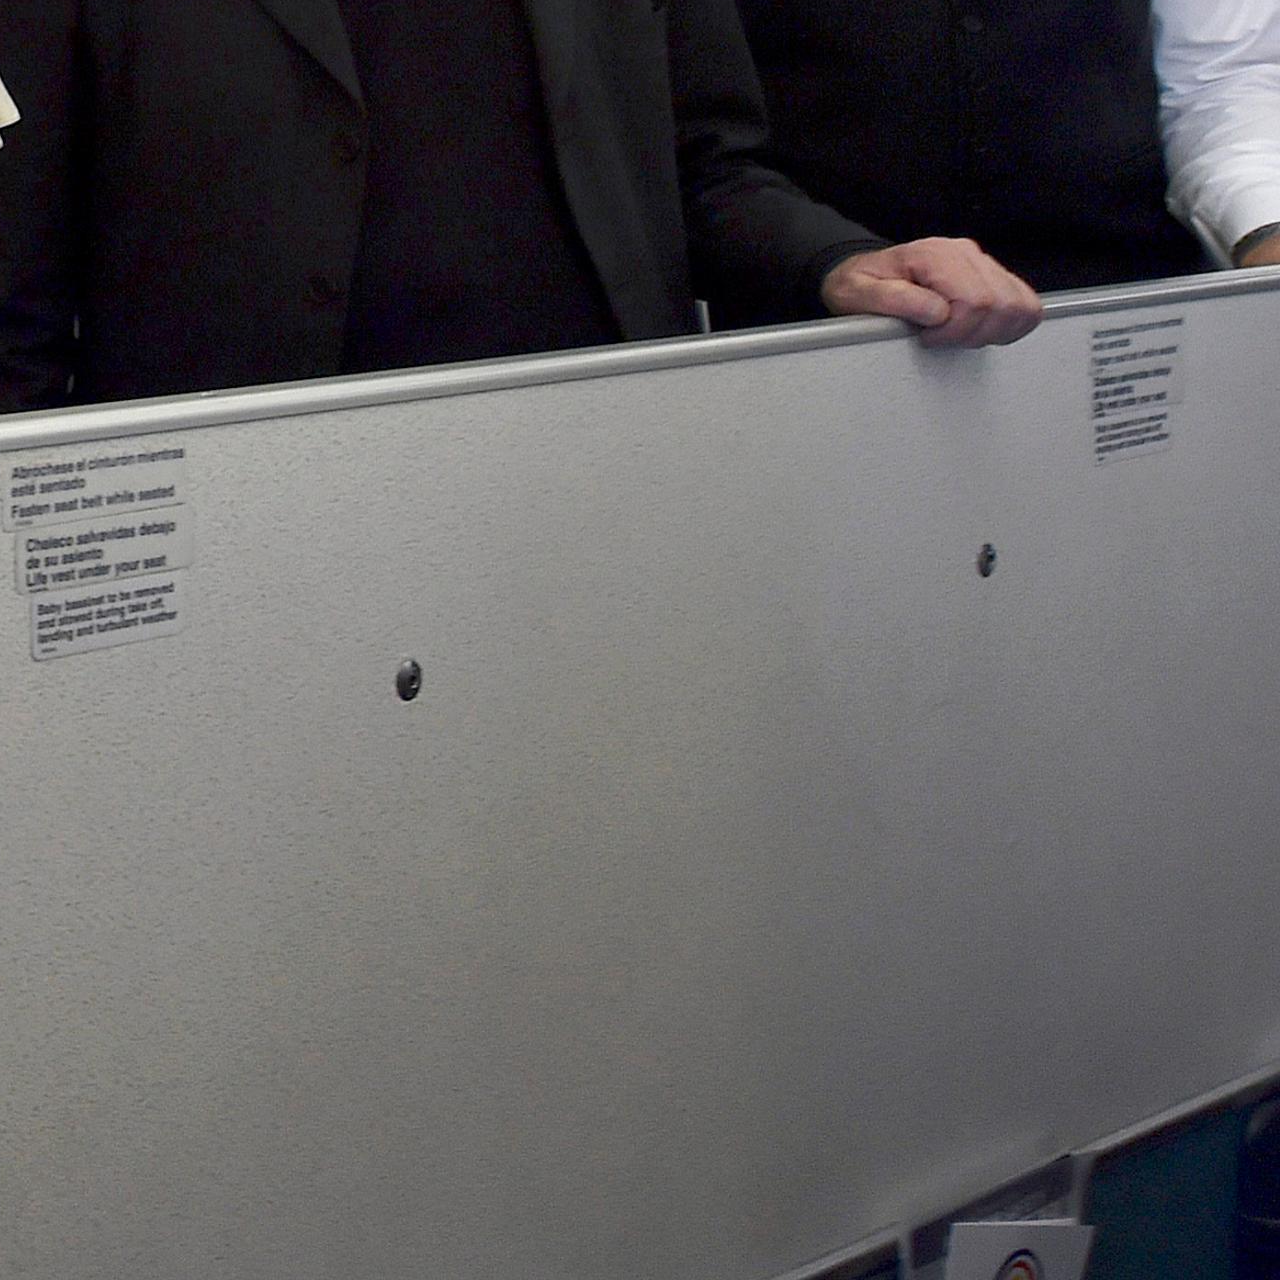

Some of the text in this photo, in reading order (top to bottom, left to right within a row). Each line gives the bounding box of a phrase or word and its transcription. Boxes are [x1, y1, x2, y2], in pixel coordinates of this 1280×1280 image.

[76, 458, 86, 471] el
[39, 476, 86, 494] sentado
[11, 484, 175, 518] Fasten seat belt while seated
[26, 521, 176, 552] Chaleco salvavidas debajo
[26, 548, 104, 569] de su asiento
[26, 555, 167, 587] Life vest under your seat
